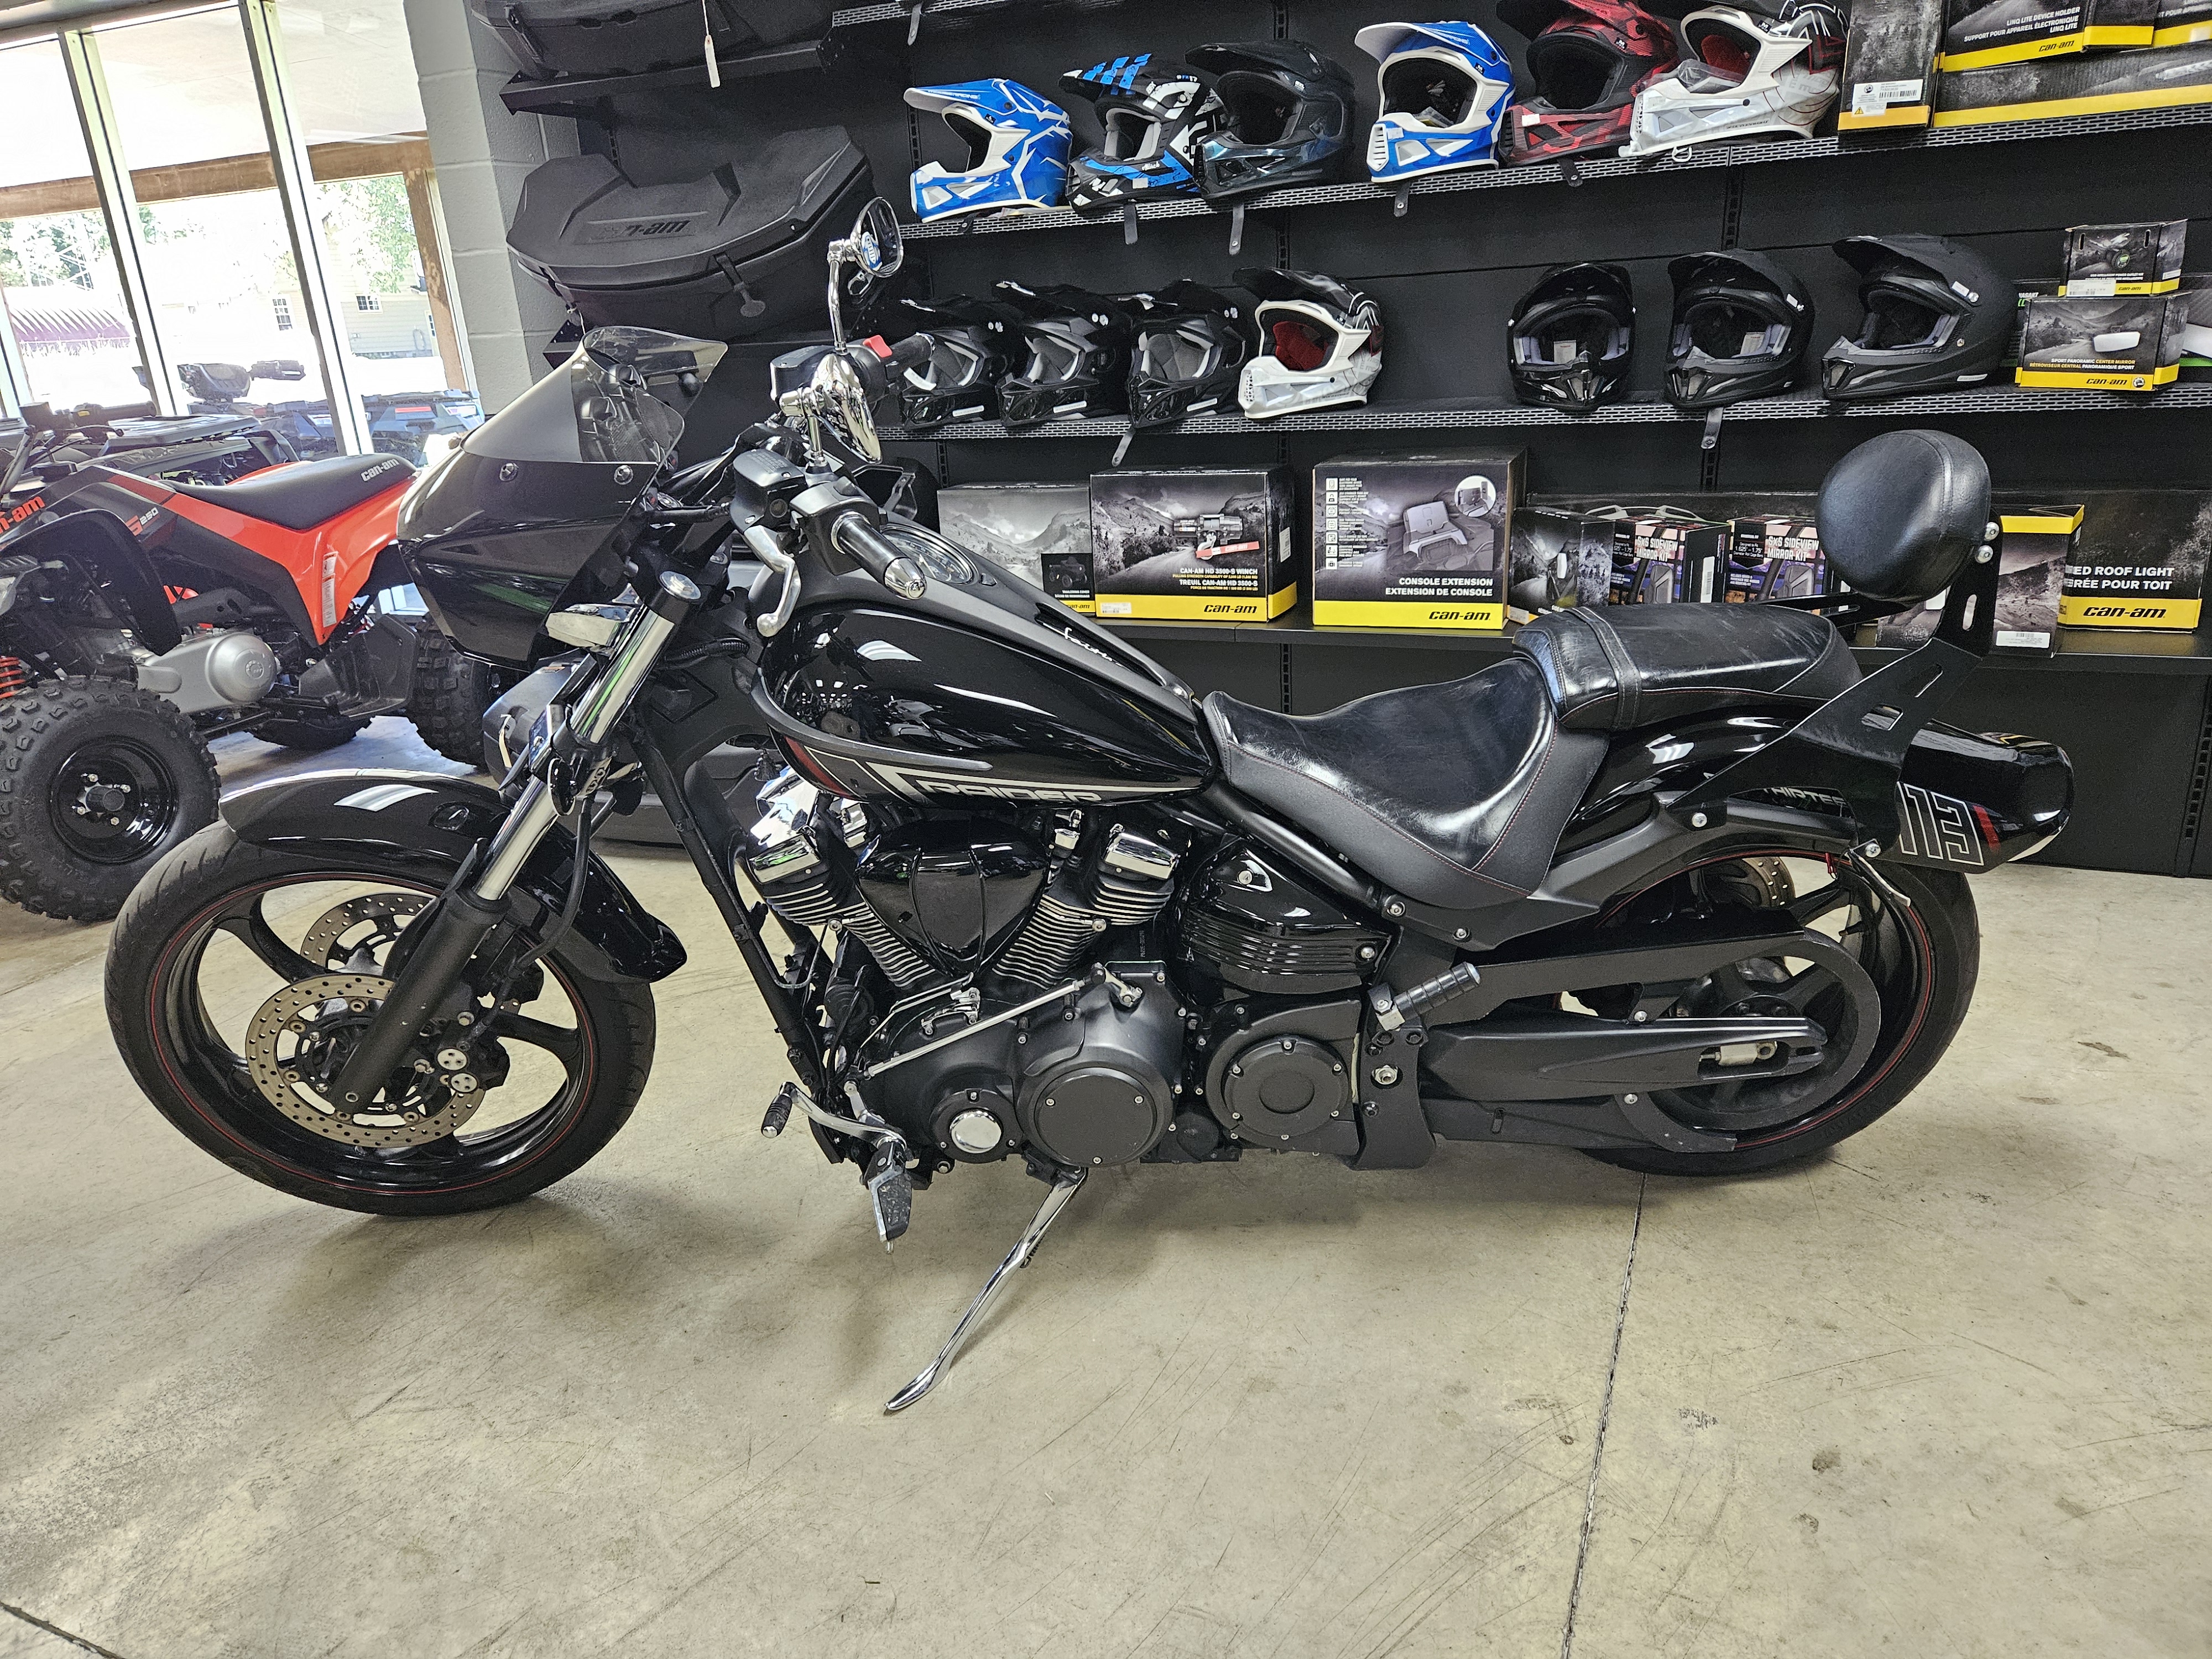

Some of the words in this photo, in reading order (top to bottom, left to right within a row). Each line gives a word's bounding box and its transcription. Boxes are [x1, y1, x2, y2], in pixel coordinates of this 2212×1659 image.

[2021, 15, 2033, 24] LITE
[2033, 12, 2054, 21] DEVICE
[2055, 6, 2080, 17] HOLDER
[1964, 33, 1989, 43] SUPPORT
[1990, 29, 2006, 38] POUR
[2006, 25, 2033, 34] APPAREIL
[2034, 15, 2079, 29] ÉLECTRONIQUE
[2049, 25, 2064, 34] LINQ
[2064, 22, 2078, 31] LITE
[2039, 40, 2074, 52] can-am
[361, 458, 400, 482] can-am
[0, 496, 45, 534] n-am
[139, 507, 159, 525] 250
[1650, 538, 1678, 551] SIDEVIEW
[1783, 537, 1819, 551] SIDEVIEW
[1636, 547, 1658, 560] MIRROR
[1658, 550, 1669, 562] KIT
[1767, 548, 1793, 560] MIRROR
[1795, 550, 1808, 562] KIT
[2095, 566, 2133, 576] ROOF
[2135, 567, 2175, 577] LIGHT
[1399, 577, 1441, 586] CONSOLE
[1441, 578, 1493, 586] EXTENSION
[2101, 580, 2140, 589] POUR
[2142, 581, 2173, 590] TOIT
[1385, 587, 1434, 596] EXTENSION
[1451, 588, 1493, 596] CONSOLE
[1203, 604, 1258, 614] can-am
[1429, 611, 1491, 620] can-am
[2083, 607, 2167, 618] can-am
[915, 780, 1102, 802] RAIDER
[1764, 787, 1847, 806] HIRTEE
